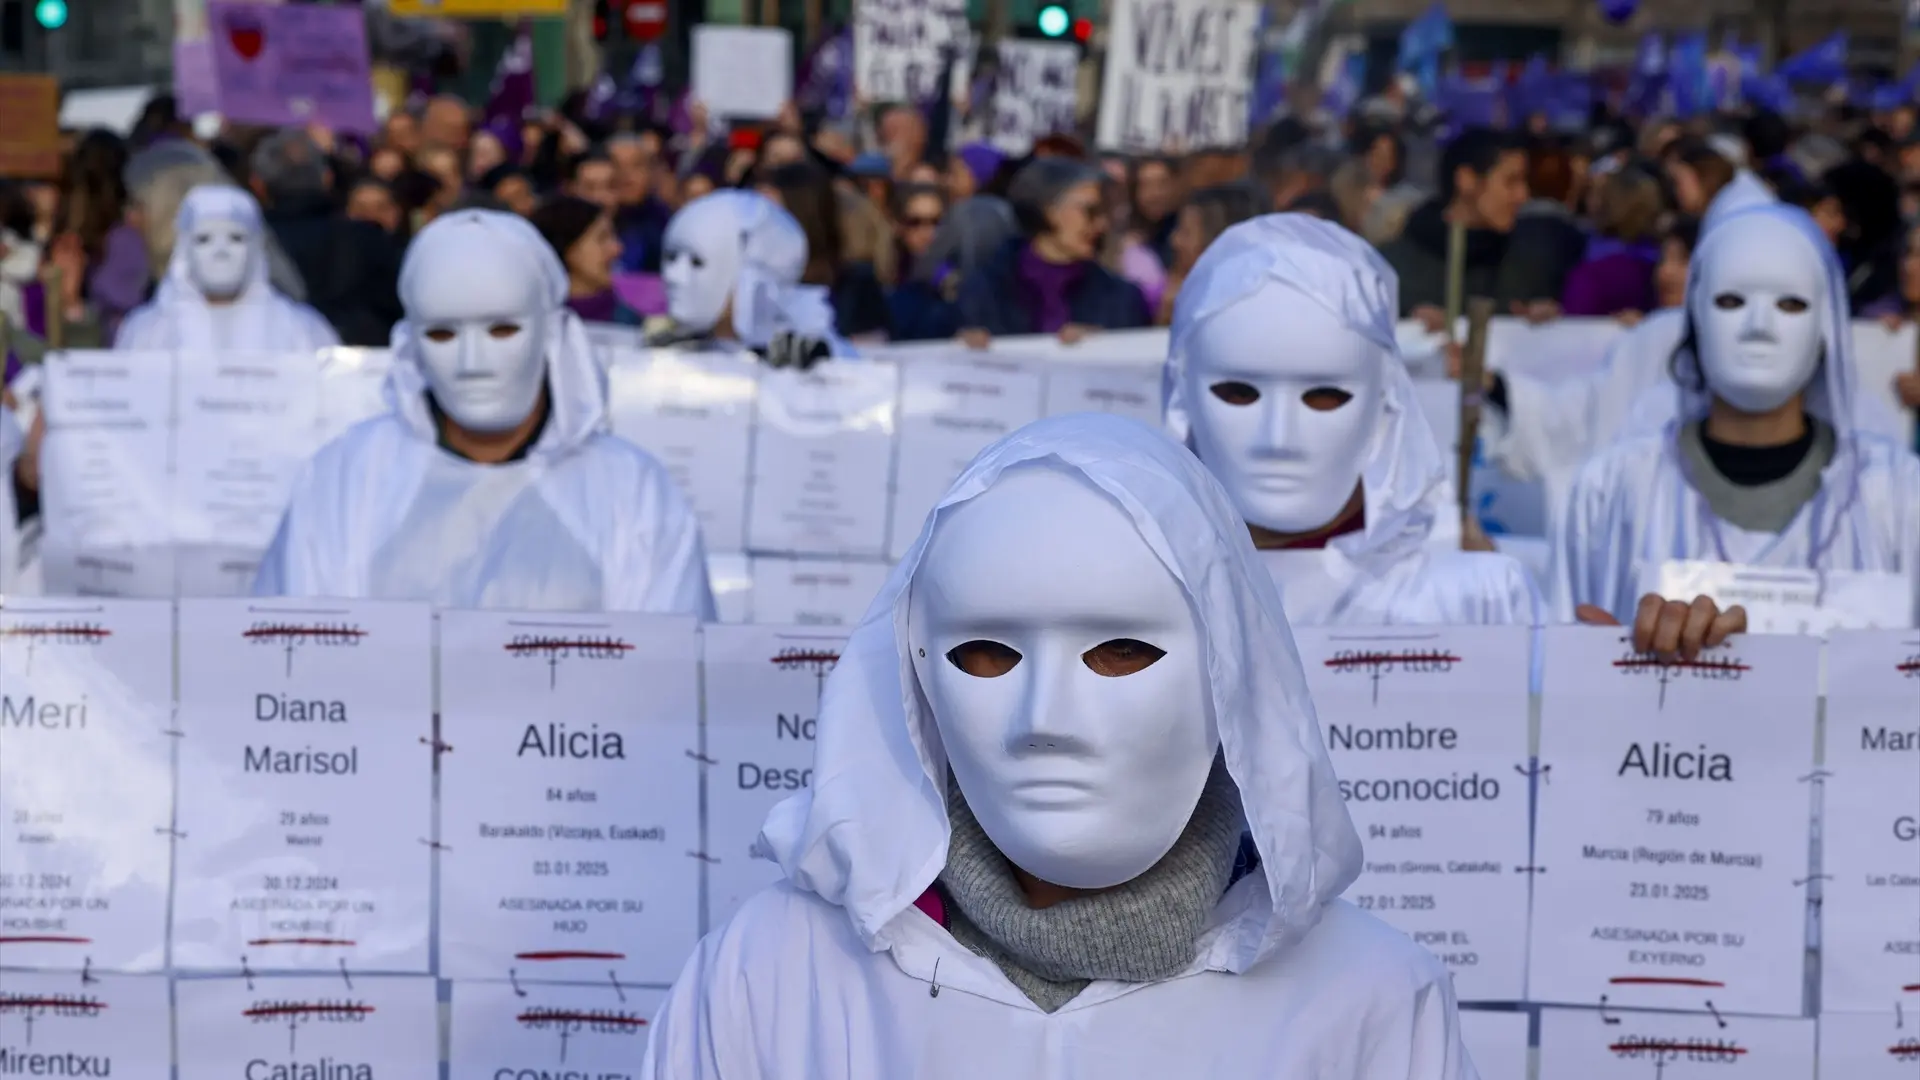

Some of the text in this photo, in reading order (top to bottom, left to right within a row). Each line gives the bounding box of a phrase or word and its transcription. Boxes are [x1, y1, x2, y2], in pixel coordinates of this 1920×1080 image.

[512, 634, 625, 659] SOMOS ELLAS
[1332, 648, 1453, 674] SOMOS ELLAS
[2, 694, 88, 729] Meri
[254, 693, 348, 723] Diana
[776, 714, 816, 741] No
[1328, 722, 1458, 751] Nombre
[1861, 726, 1920, 751] Mar
[517, 723, 626, 759] Alicia
[244, 745, 358, 775] Marisol
[1617, 742, 1734, 782] Alicia
[737, 762, 814, 791] Desc
[1338, 773, 1500, 801] sconocido
[566, 788, 598, 802] años
[299, 811, 331, 826] años
[479, 823, 545, 838] Barakaldo
[1667, 810, 1701, 827] años
[1390, 825, 1422, 839] años
[1582, 844, 1629, 862] Murcia
[1689, 849, 1706, 864] de
[1710, 851, 1763, 869] Murcia)
[498, 897, 644, 913] ASESINADA POR SU
[553, 920, 588, 933] HIJO
[1414, 931, 1447, 944] POR
[1590, 927, 1745, 948] ASESINADA POR SU
[1616, 1033, 1738, 1064] SOMOS ELLAS
[245, 1056, 373, 1080] Catalina
